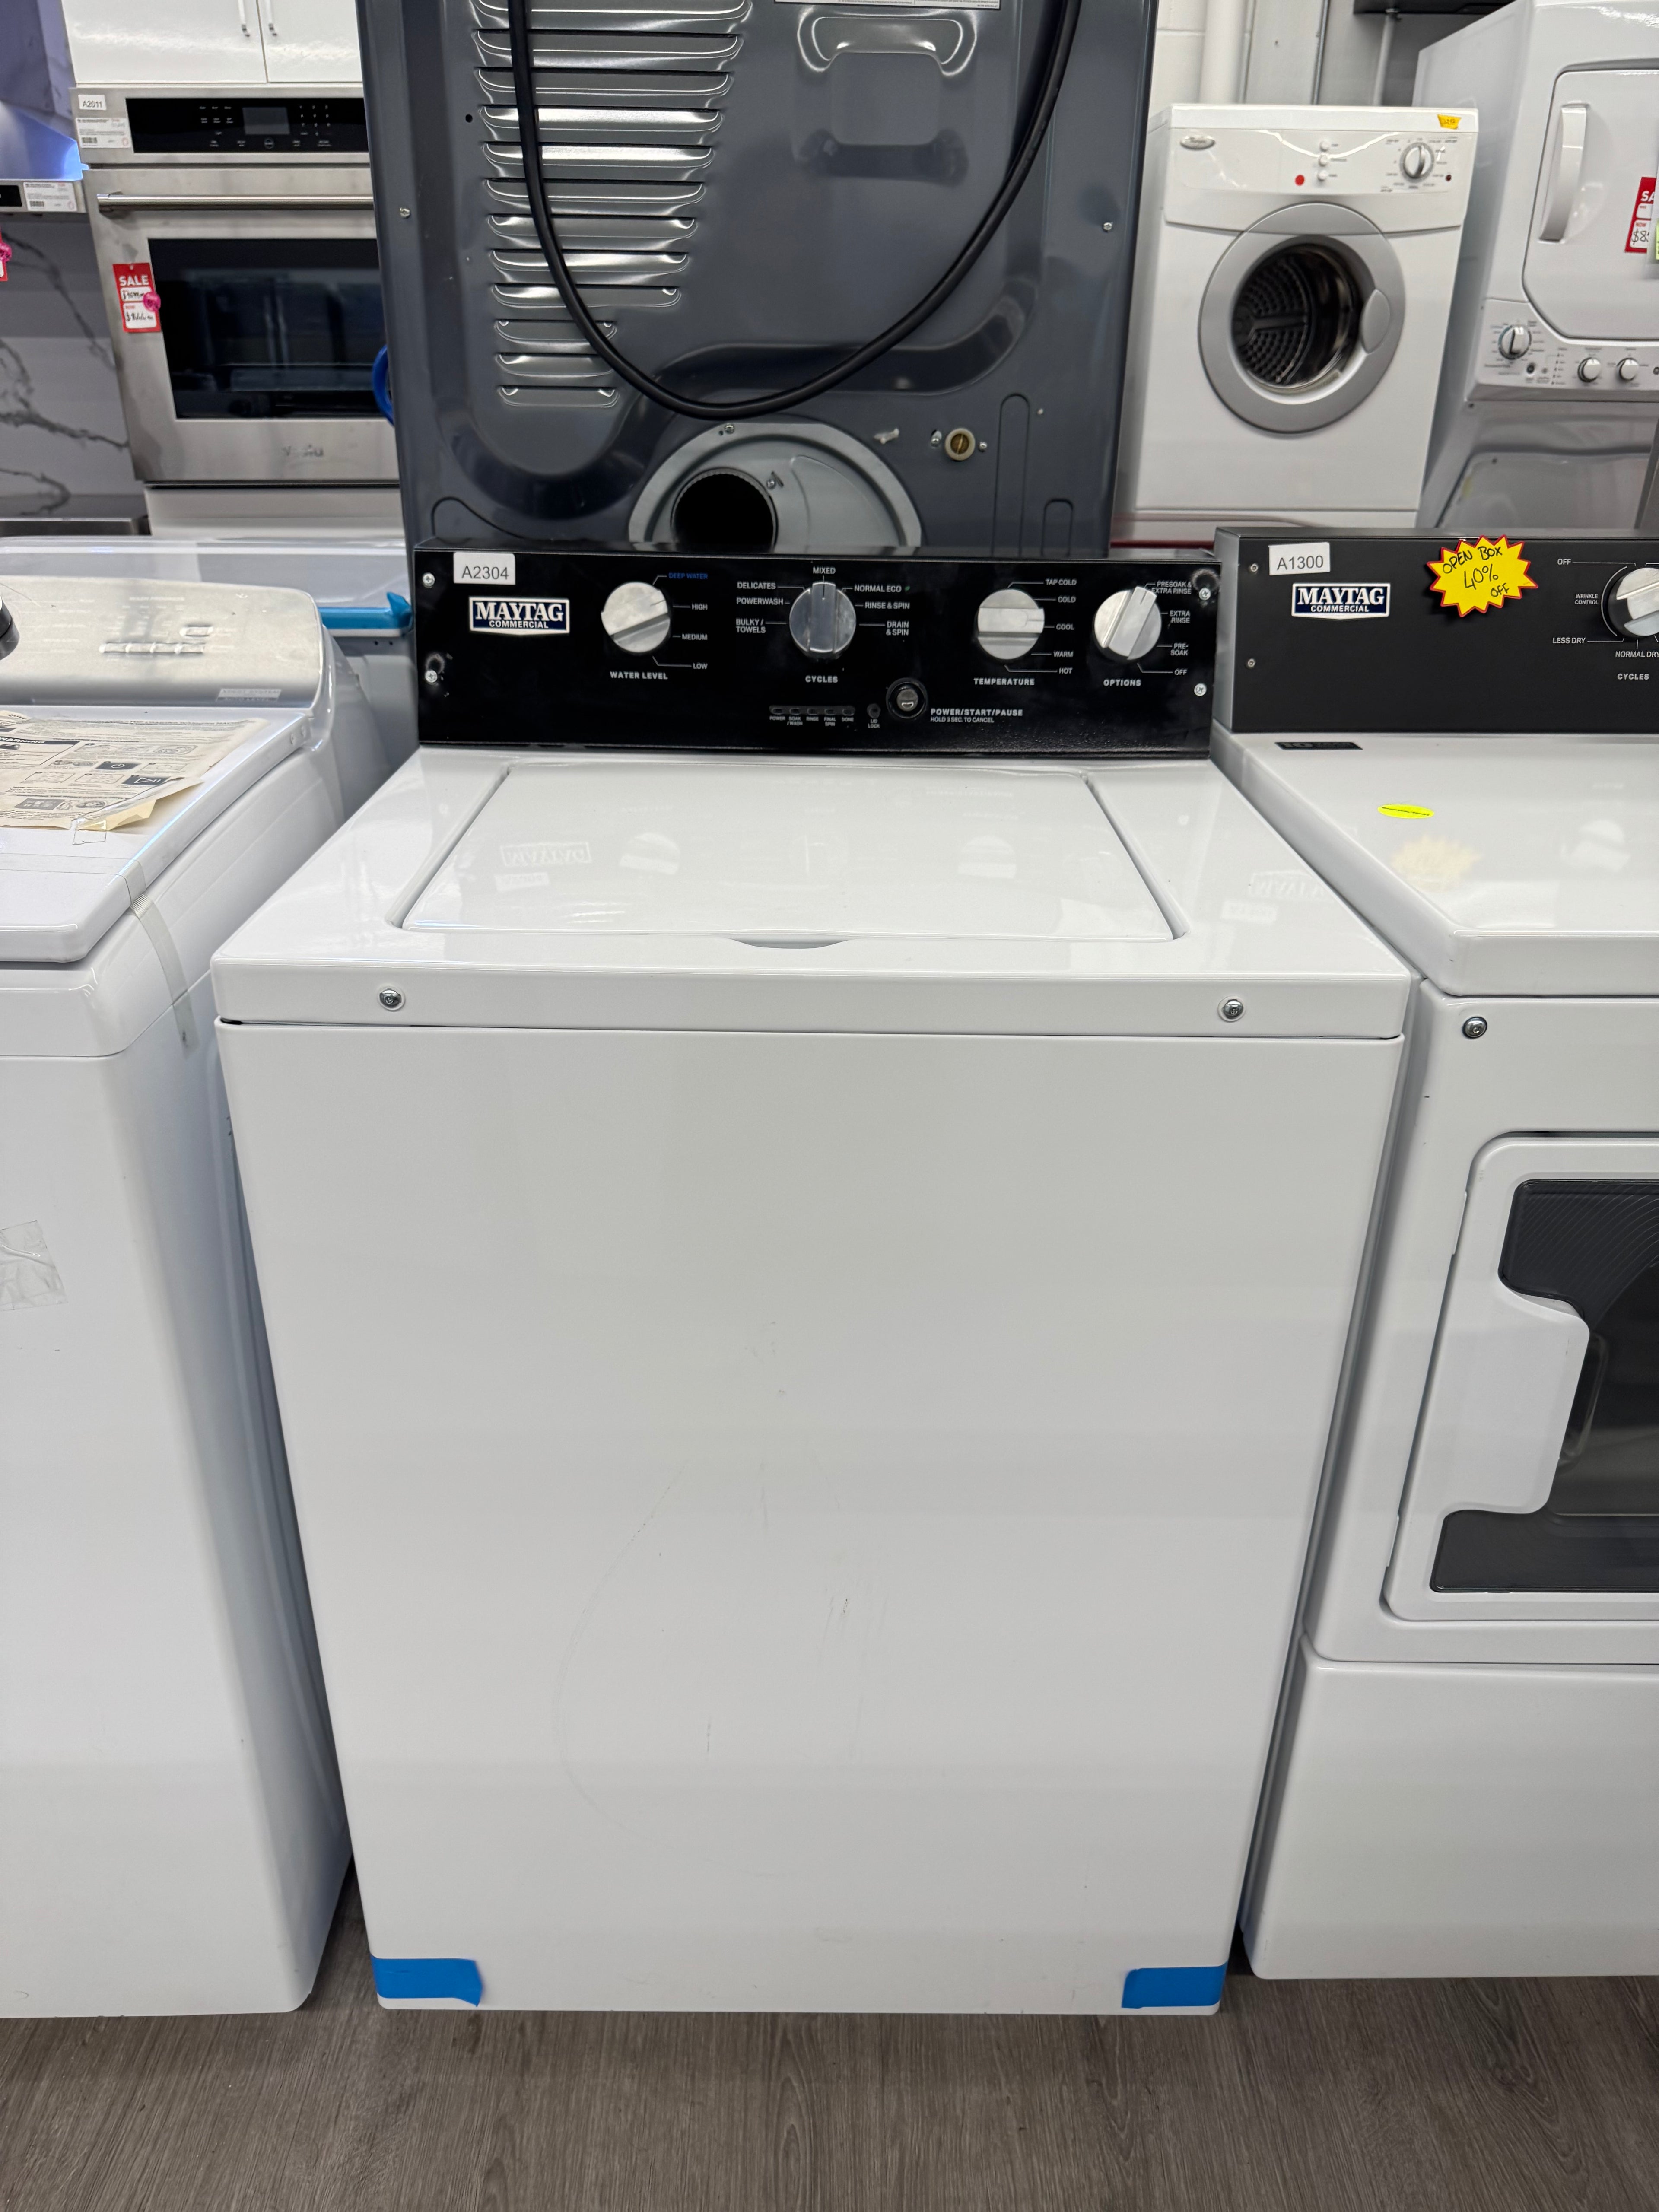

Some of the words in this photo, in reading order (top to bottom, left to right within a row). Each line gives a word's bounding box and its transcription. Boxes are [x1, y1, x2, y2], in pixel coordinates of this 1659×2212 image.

[1641, 191, 1654, 202] SA
[119, 275, 149, 286] SALE
[1277, 556, 1324, 571] A1300
[1443, 550, 1473, 574] OPEN
[1478, 546, 1502, 560] BOX
[461, 566, 509, 580] A2304
[1464, 563, 1498, 590] 40%
[1297, 588, 1384, 605] MAYTAG
[1490, 582, 1510, 597] OFF
[475, 602, 563, 621] MAYTAG
